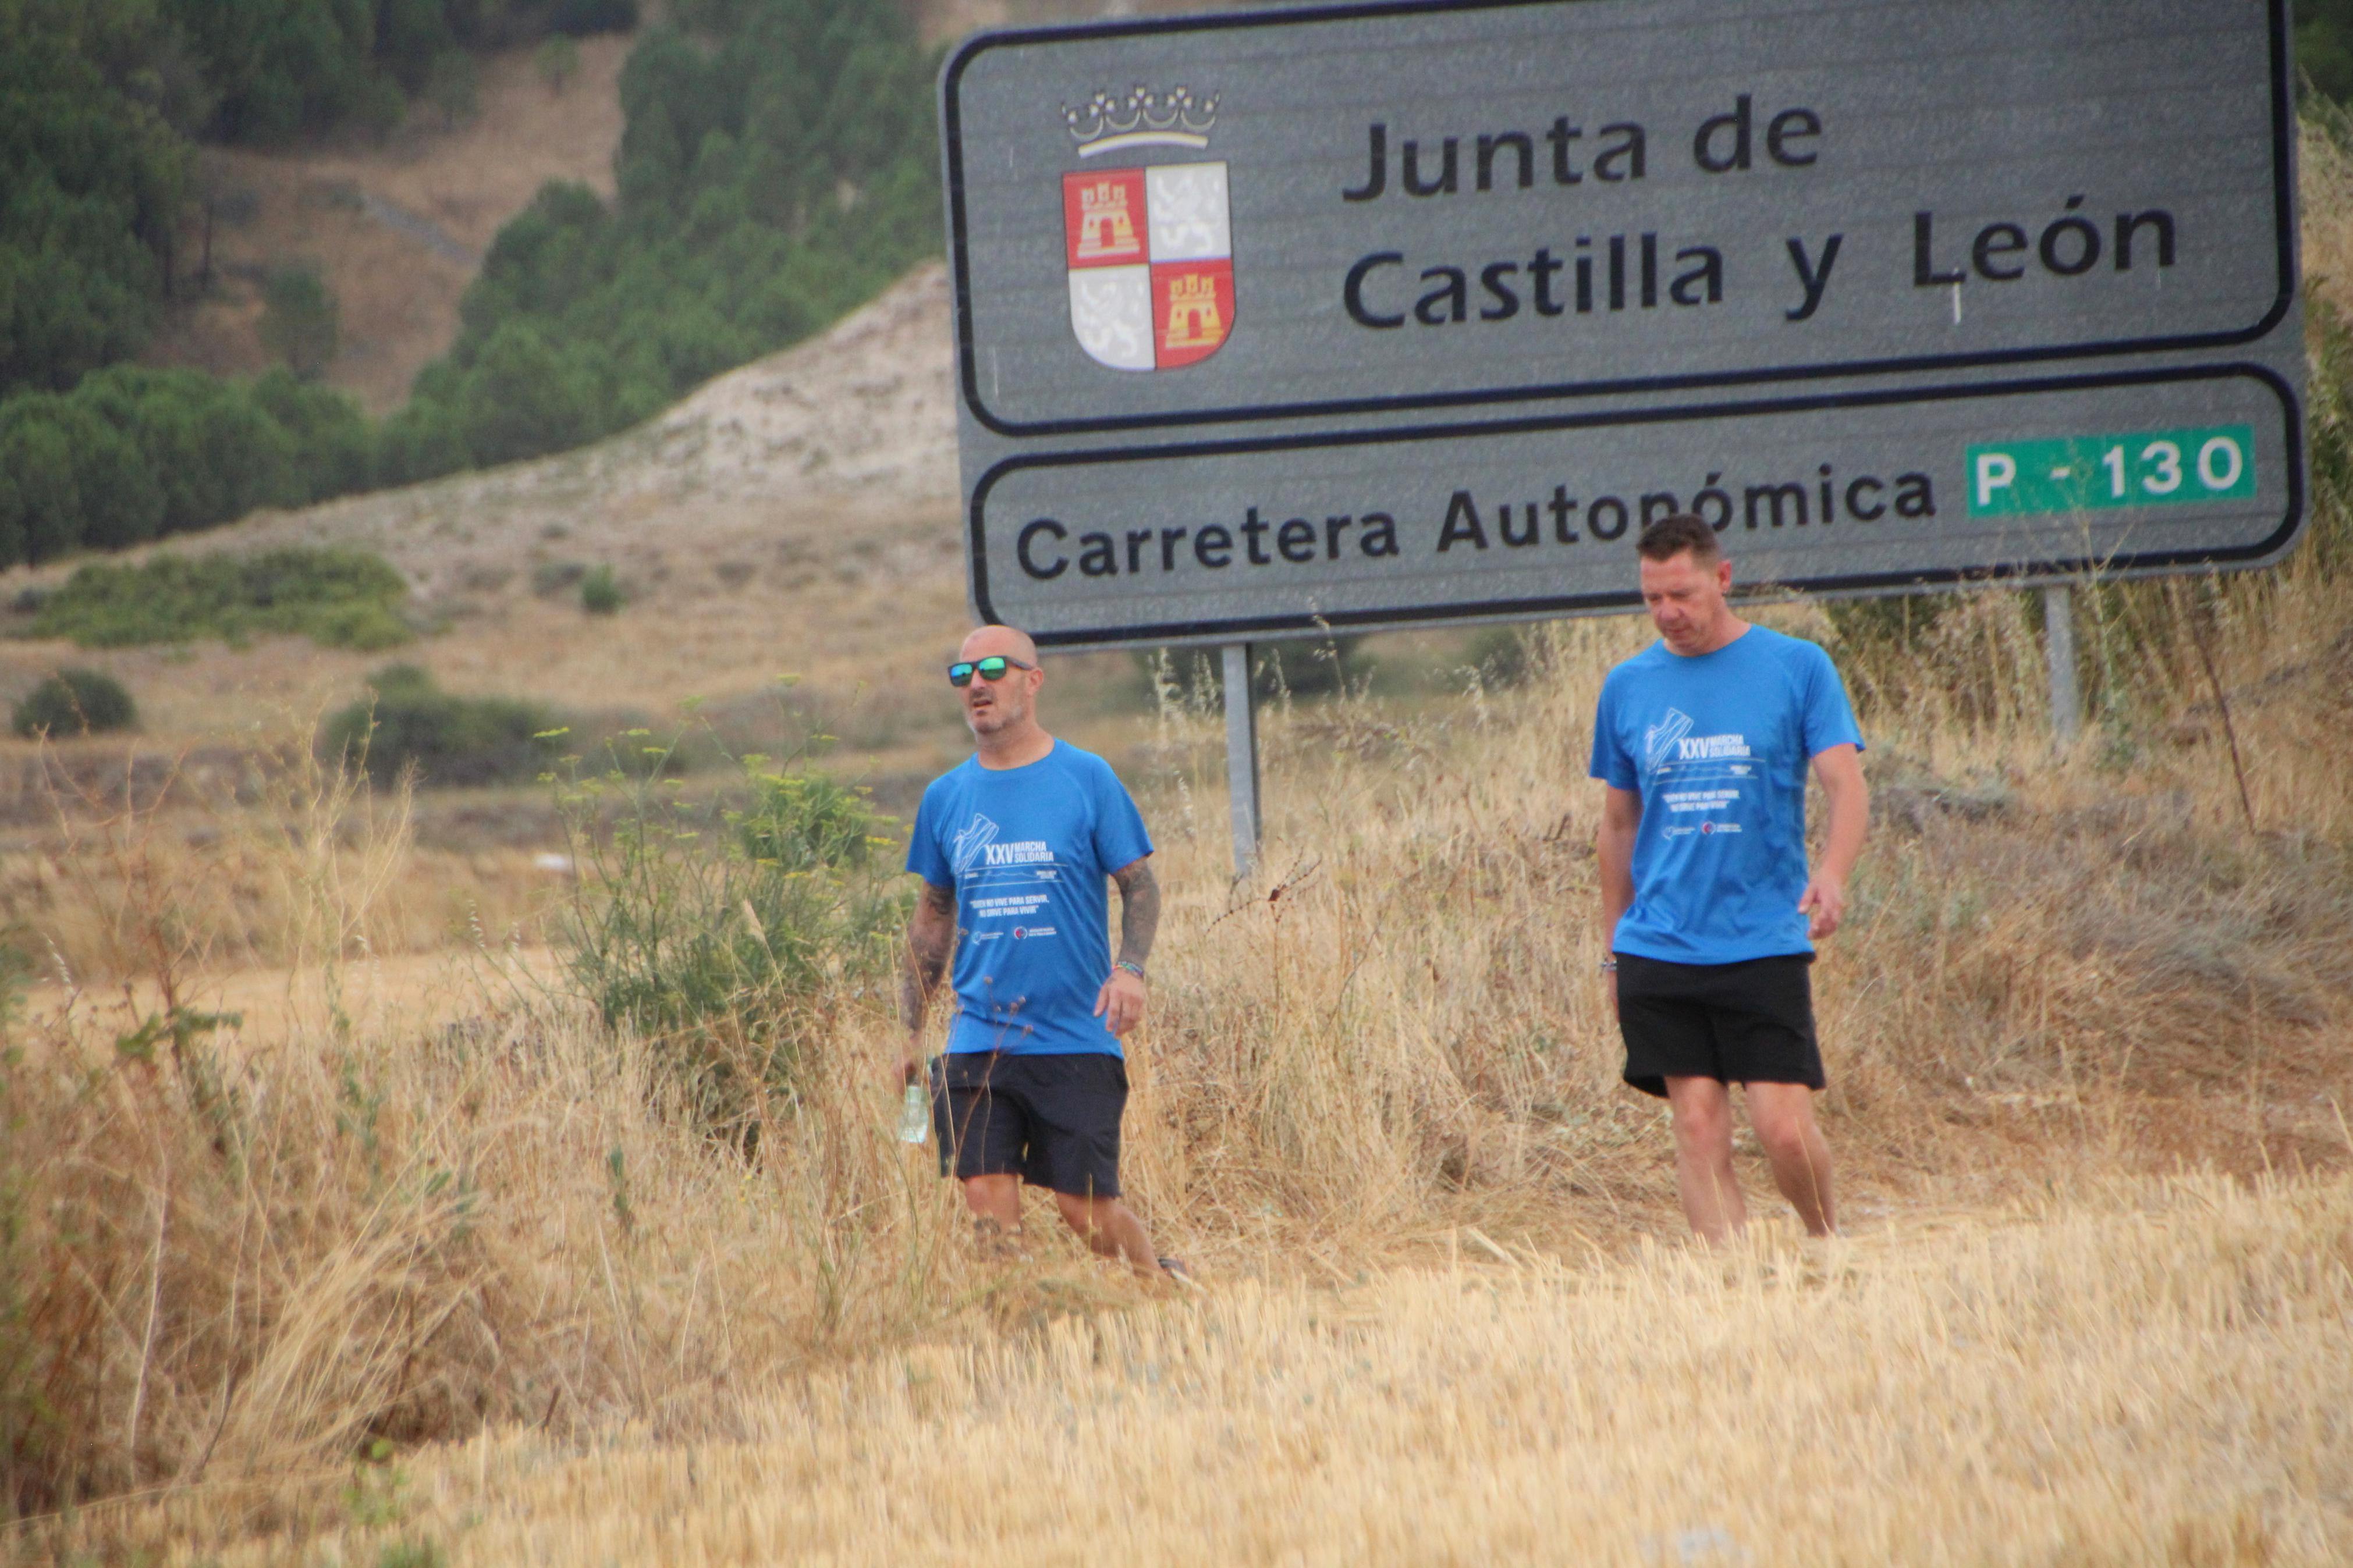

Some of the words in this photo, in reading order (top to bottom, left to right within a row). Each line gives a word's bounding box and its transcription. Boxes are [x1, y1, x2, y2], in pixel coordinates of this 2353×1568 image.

[1342, 115, 1647, 202] Junta
[1692, 93, 1824, 175] de
[1343, 232, 1724, 330] Castilla
[1783, 233, 1845, 323] y
[1911, 192, 2178, 289] León
[1016, 507, 1400, 581] Carretera
[1436, 463, 1937, 553] Autonómica
[1679, 737, 1709, 760] XXV
[985, 844, 1014, 865] XXV
[1014, 841, 1047, 852] MARCHA
[1014, 851, 1054, 863] SOLIDARIA
